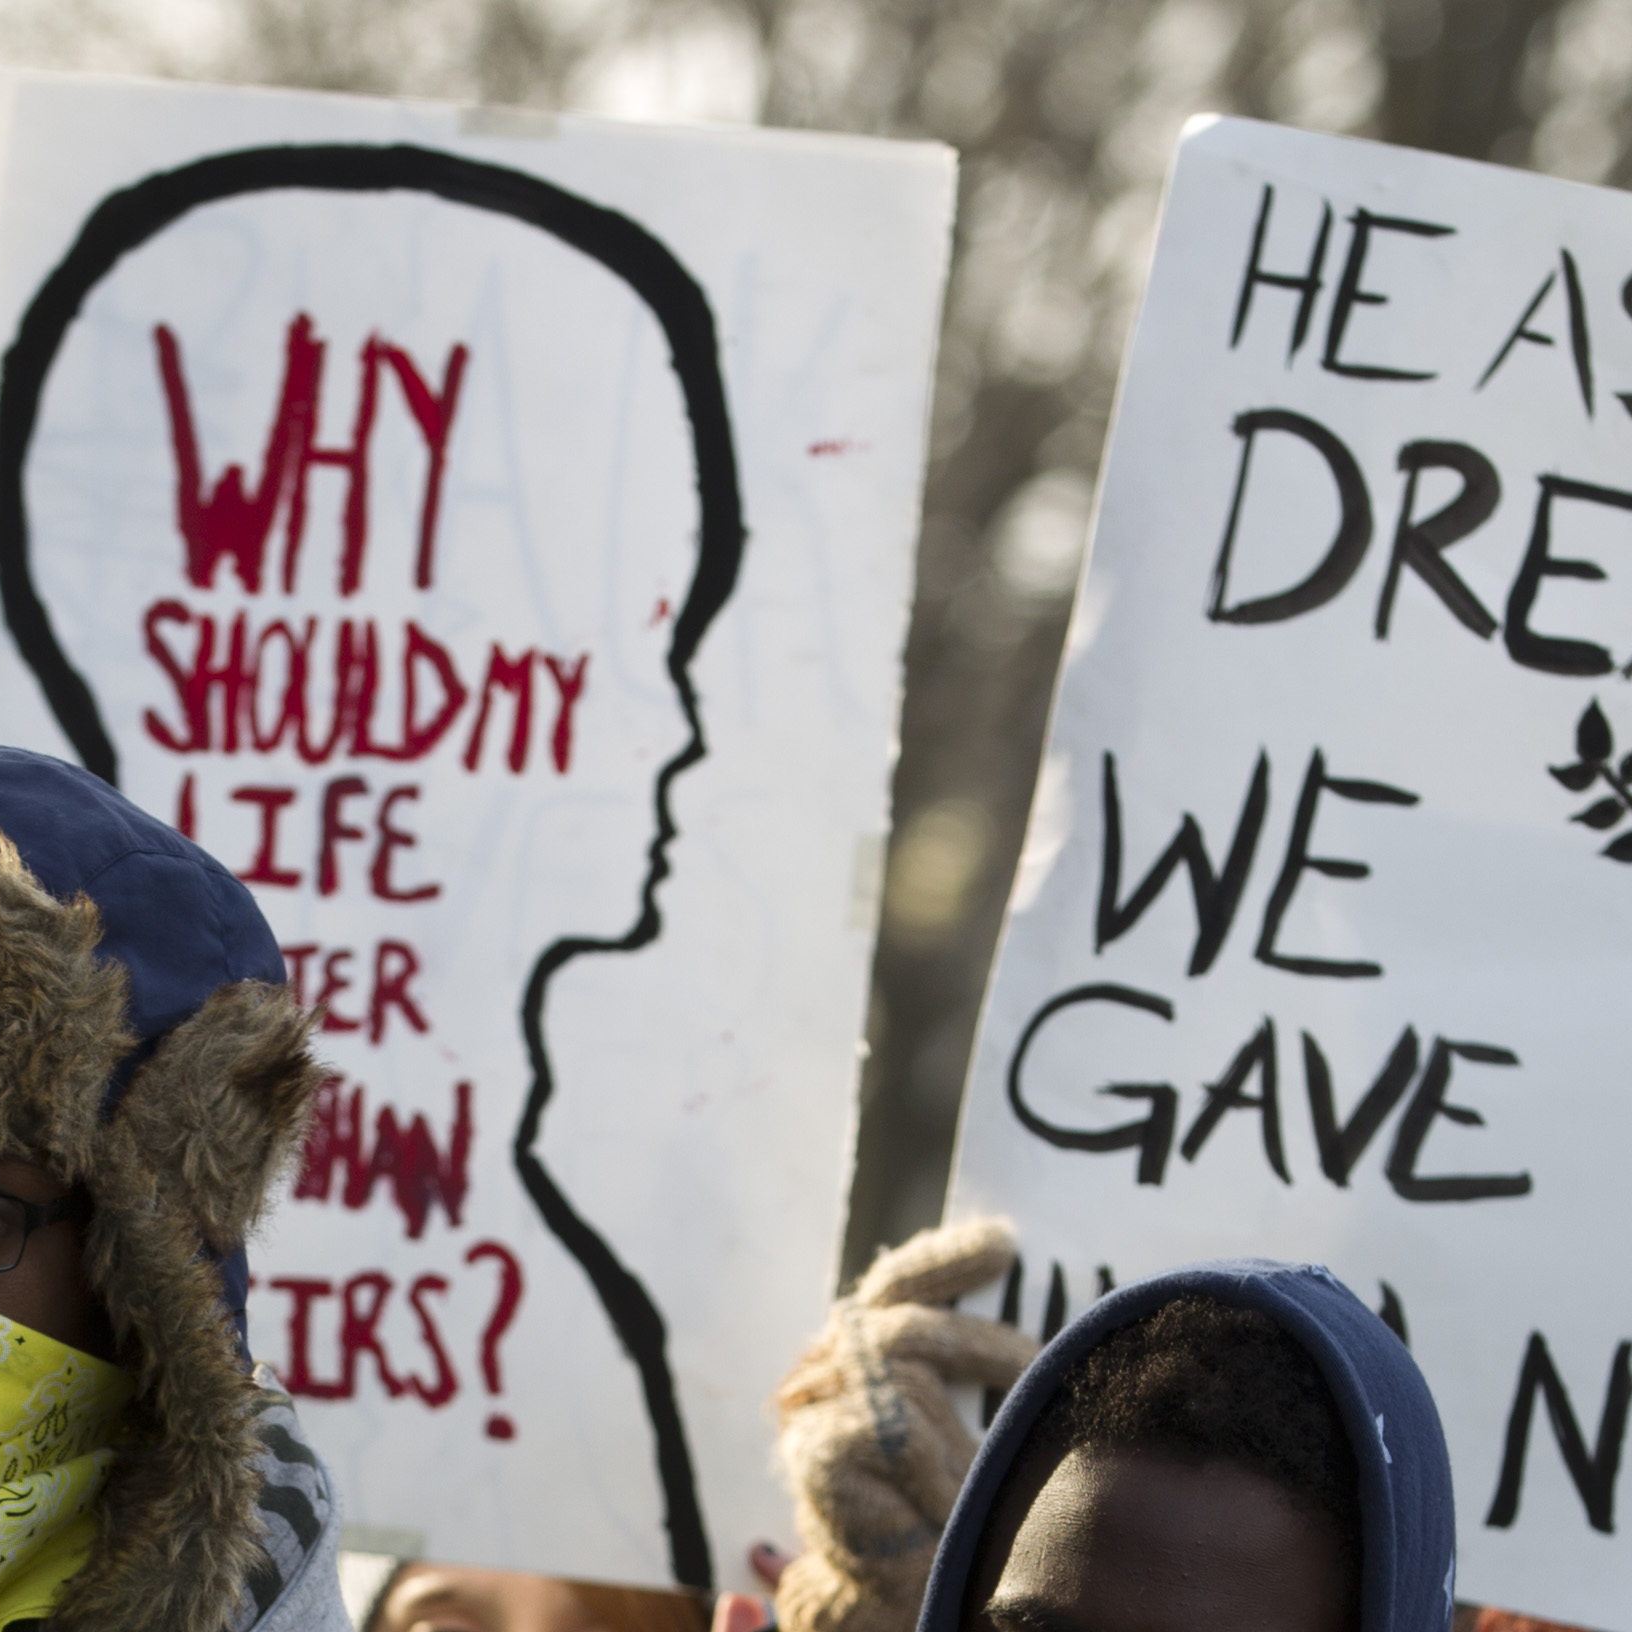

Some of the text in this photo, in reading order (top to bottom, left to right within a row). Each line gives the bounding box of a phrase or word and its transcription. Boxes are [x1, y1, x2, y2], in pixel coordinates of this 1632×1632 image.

[1229, 183, 1457, 382] HE
[154, 311, 468, 598] WHY
[142, 597, 591, 774] SHOULD MY
[1096, 744, 1421, 978] WE
[280, 937, 431, 1047] TER
[1006, 982, 1533, 1202] GAVE
[249, 1240, 524, 1440] IRS?
